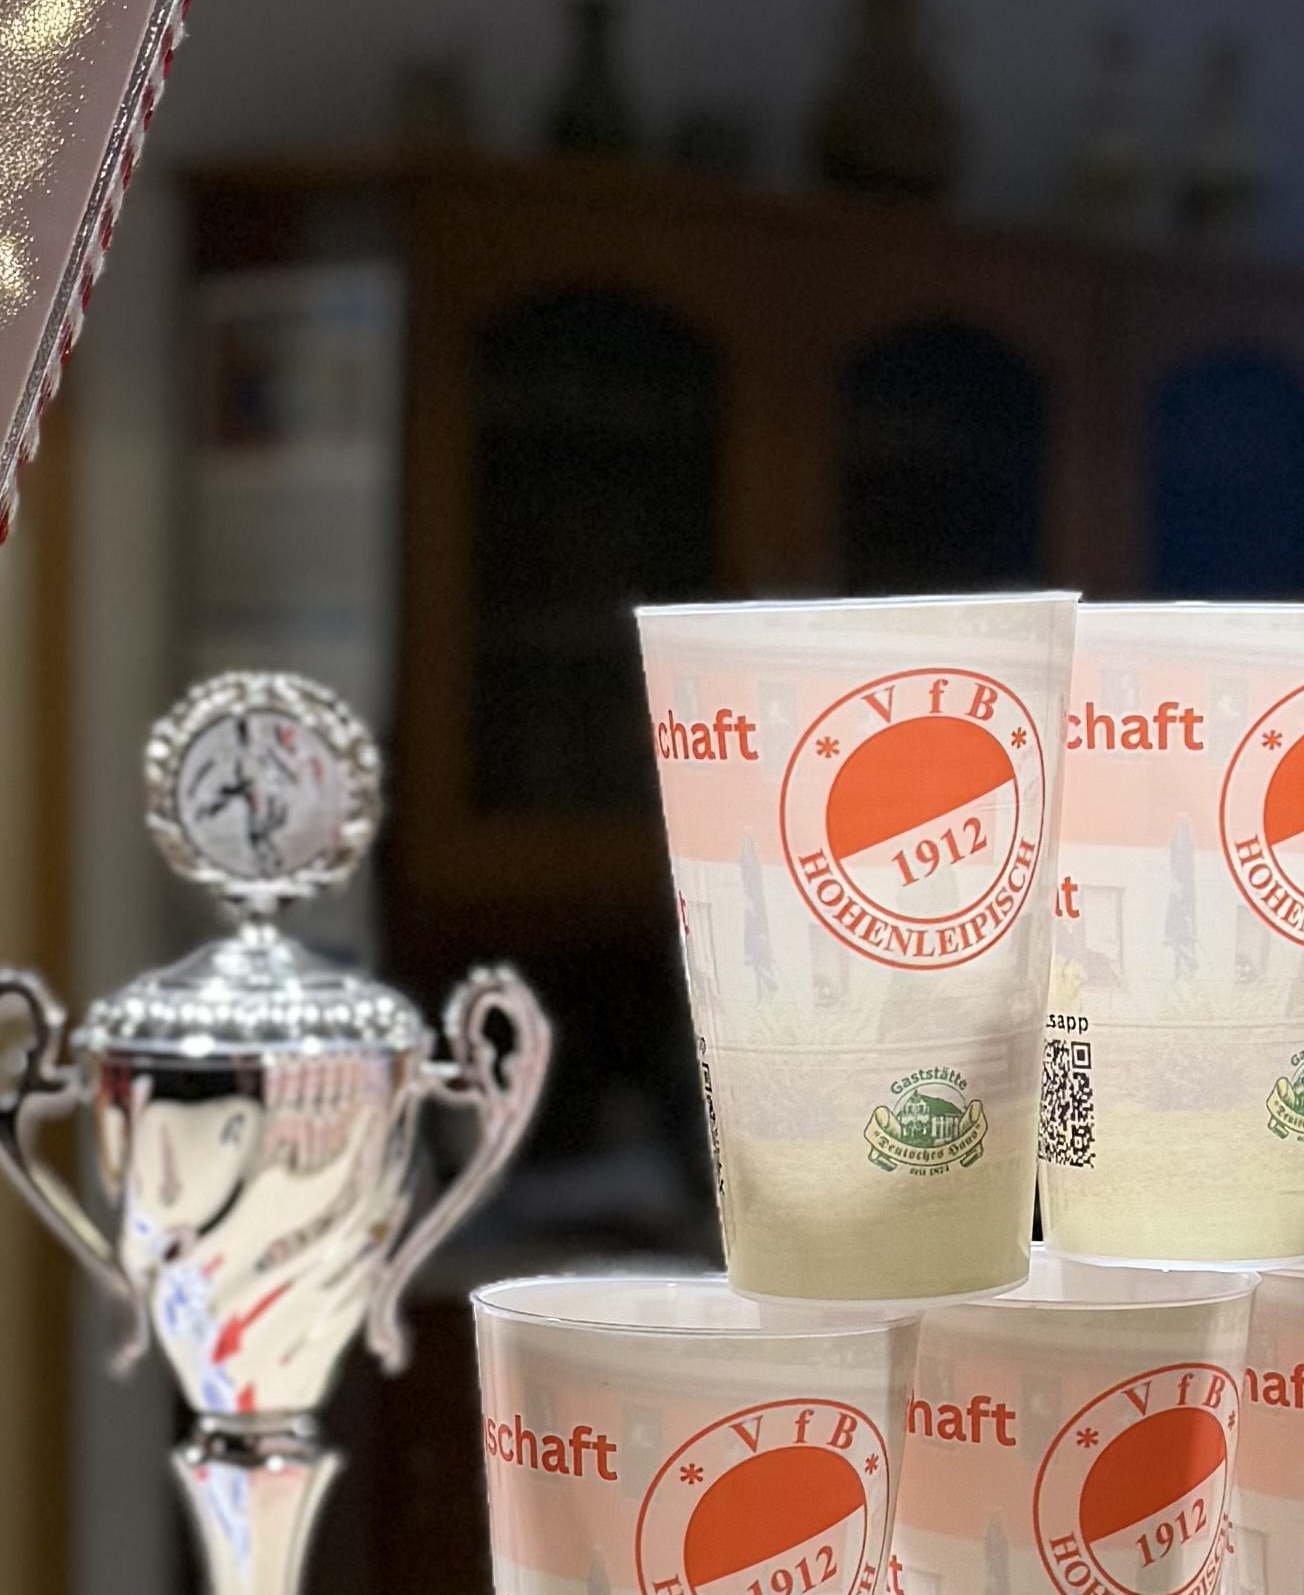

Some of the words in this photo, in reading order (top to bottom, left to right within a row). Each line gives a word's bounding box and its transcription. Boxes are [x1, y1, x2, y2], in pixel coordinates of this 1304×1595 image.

[891, 816, 988, 888] 1912
[798, 836, 1036, 957] HOHENLEIPISCH
[890, 1066, 968, 1095] Gaststätte
[483, 1413, 618, 1482] schaft
[1135, 1497, 1207, 1569] 1912
